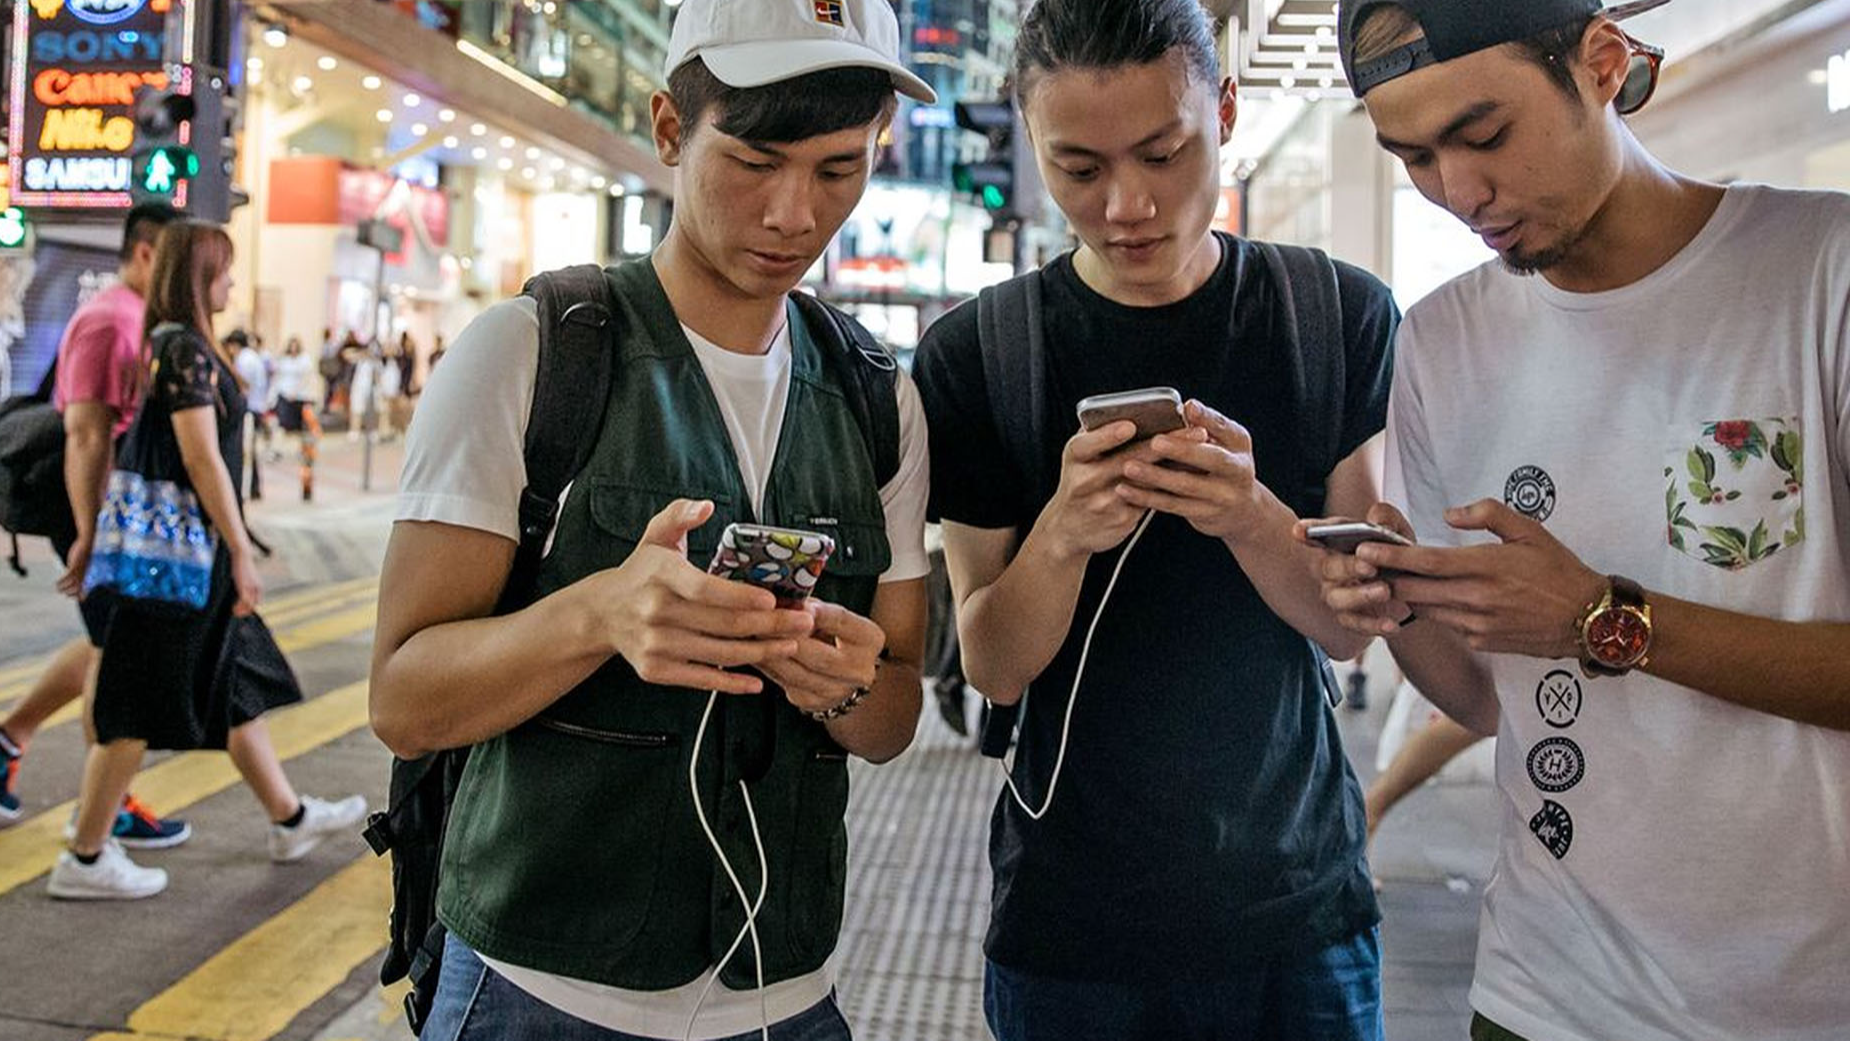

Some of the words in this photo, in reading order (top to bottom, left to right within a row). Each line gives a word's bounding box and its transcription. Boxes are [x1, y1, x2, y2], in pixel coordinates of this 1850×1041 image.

[34, 30, 163, 62] SONY
[38, 107, 135, 151] Niko
[24, 157, 132, 190] SAMSU
[1549, 758, 1563, 771] H
